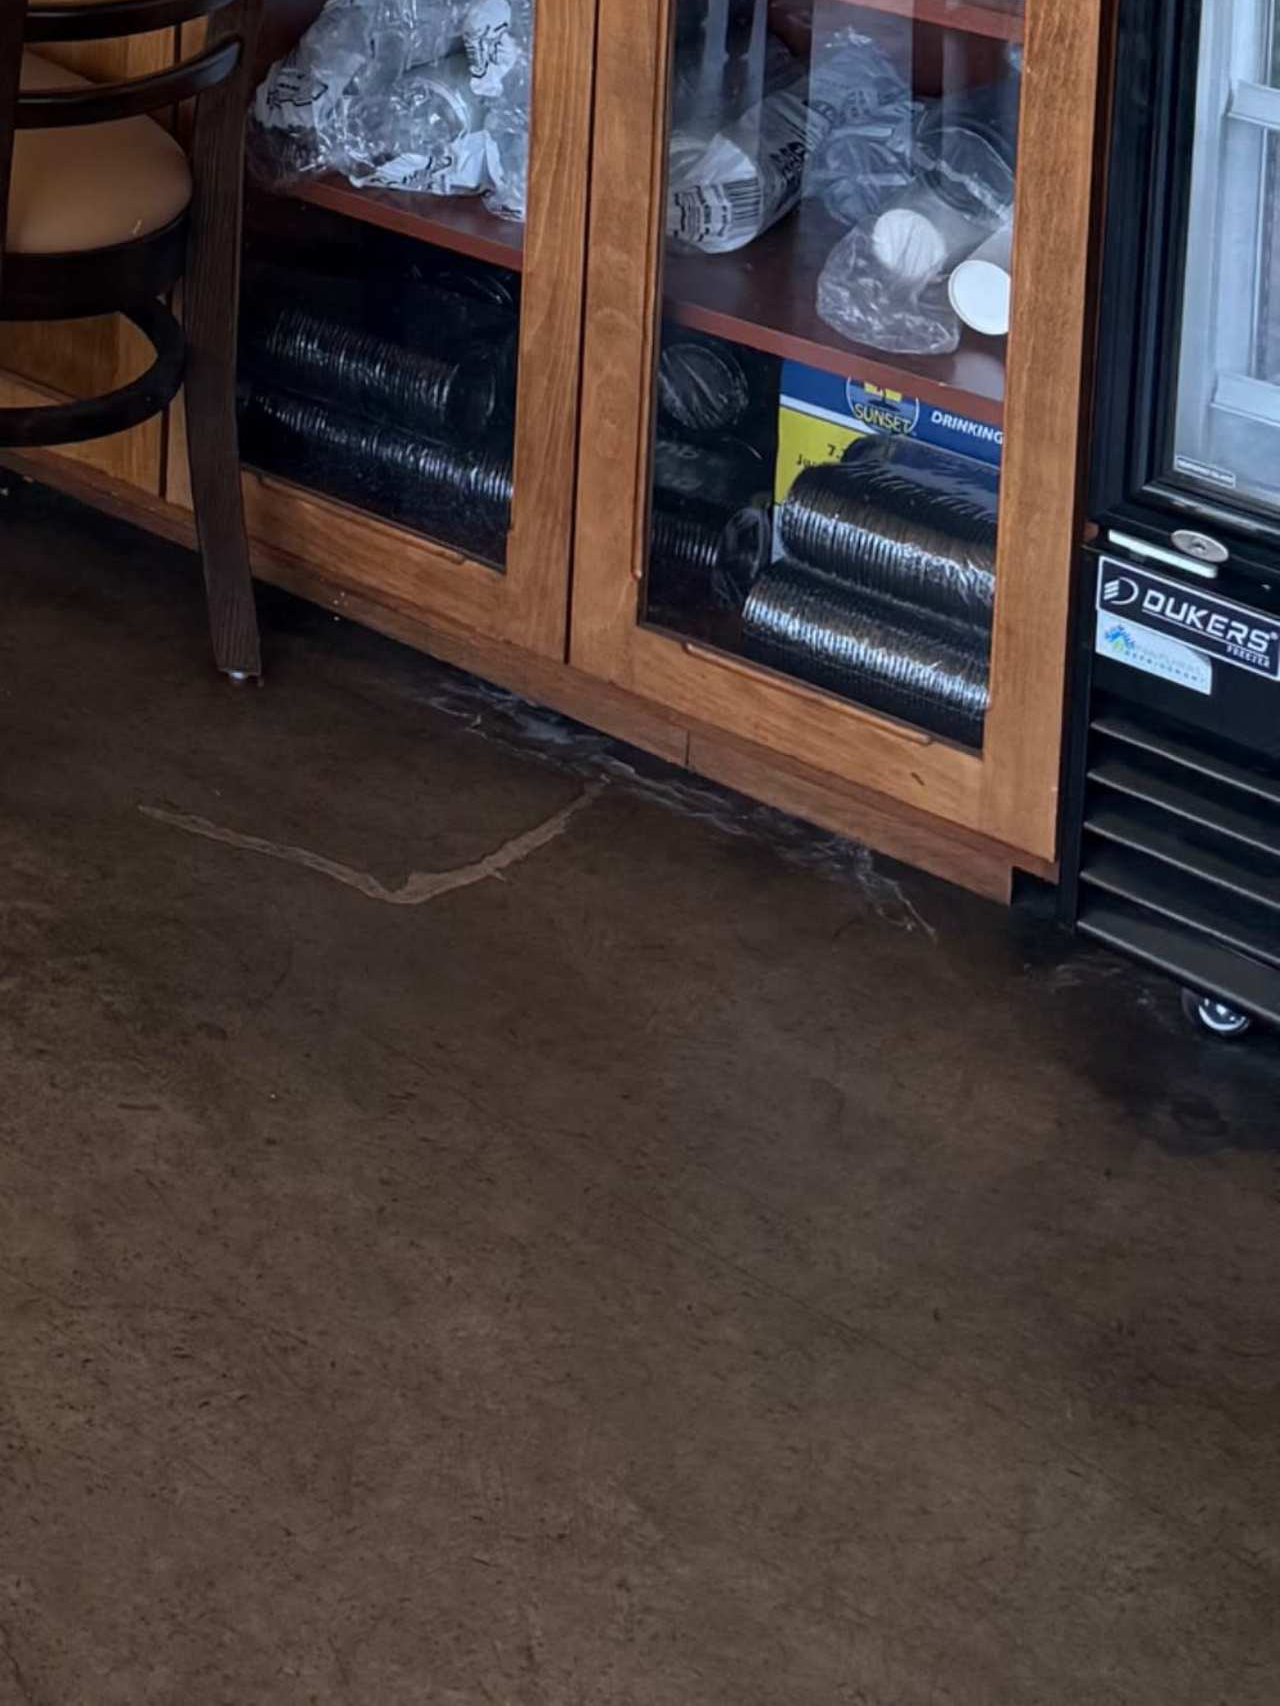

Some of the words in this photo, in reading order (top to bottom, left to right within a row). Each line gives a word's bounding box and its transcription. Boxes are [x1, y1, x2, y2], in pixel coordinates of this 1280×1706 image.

[852, 402, 912, 436] SUNSET
[929, 409, 1004, 445] DRINKING
[1141, 588, 1270, 654] DUKERS
